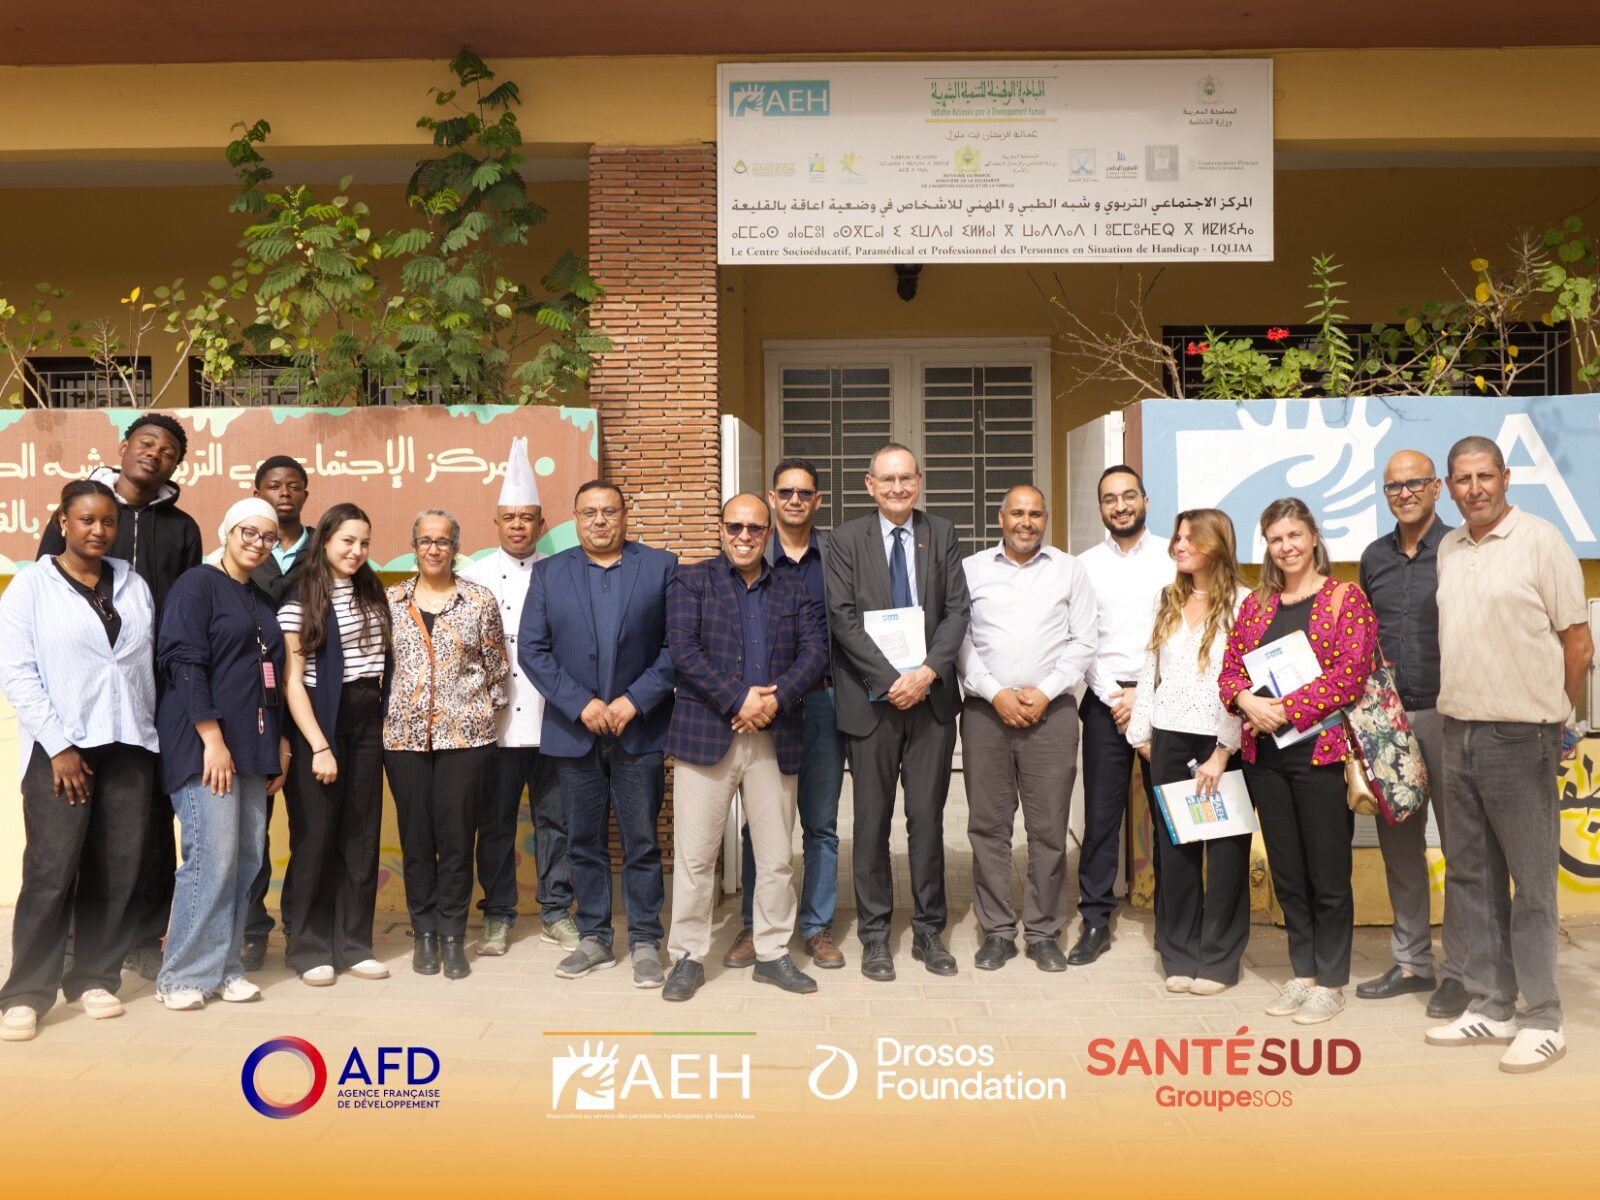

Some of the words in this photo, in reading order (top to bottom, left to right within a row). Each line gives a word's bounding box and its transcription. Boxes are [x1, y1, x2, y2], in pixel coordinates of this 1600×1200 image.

[765, 88, 829, 112] AEH
[731, 198, 787, 215] بالقليعة
[790, 198, 825, 211] اعاقة
[828, 198, 877, 214] وضعية
[879, 197, 894, 218] في
[965, 198, 1005, 218] المهني
[1008, 201, 1015, 213] و
[1017, 197, 1057, 217] الطبي
[1060, 195, 1091, 213] شبه
[1094, 200, 1101, 212] و
[1103, 197, 1148, 216] التربوي
[1150, 196, 1217, 216] الاجتماعي
[1219, 195, 1253, 212] المركز
[731, 246, 743, 257] Le
[746, 246, 780, 257] Centre
[783, 245, 852, 258] Socioéducatif,
[855, 245, 915, 257] Paramédical
[918, 247, 928, 256] et
[931, 244, 997, 256] Professionnel
[1000, 245, 1016, 256] des
[1020, 244, 1069, 256] Personnes
[1072, 247, 1084, 255] en
[1087, 243, 1133, 255] Situation
[1136, 243, 1149, 255] de
[1152, 243, 1201, 257] Handicap
[425, 436, 529, 486] مركز
[1461, 412, 1598, 542] A
